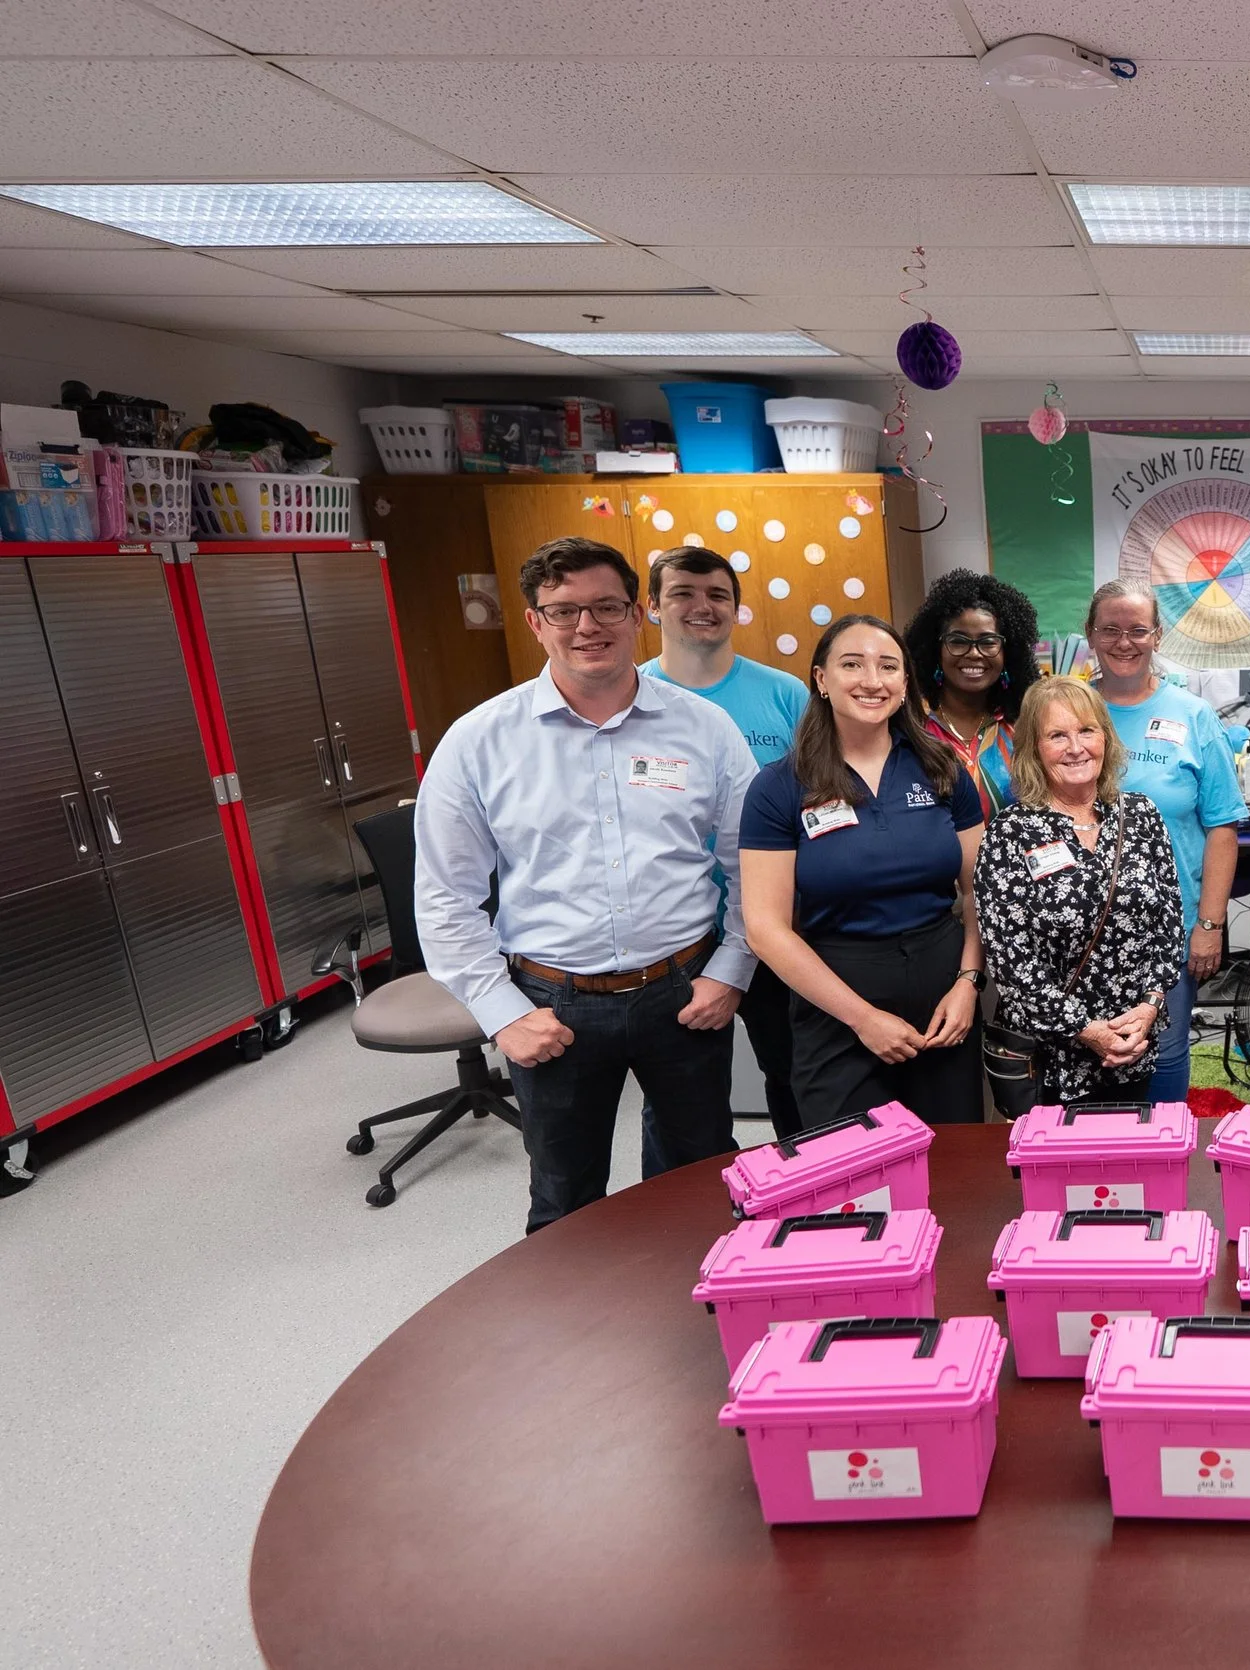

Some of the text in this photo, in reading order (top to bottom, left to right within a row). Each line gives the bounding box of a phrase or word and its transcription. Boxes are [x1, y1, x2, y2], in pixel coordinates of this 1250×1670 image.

[1111, 471, 1145, 510] IT'S
[1140, 450, 1178, 486] OKAY
[1183, 447, 1204, 471] TO
[1210, 446, 1245, 473] FEEL
[744, 730, 779, 746] nker
[1129, 750, 1169, 764] anker
[906, 790, 934, 803] Park
[1220, 1479, 1234, 1489] link
